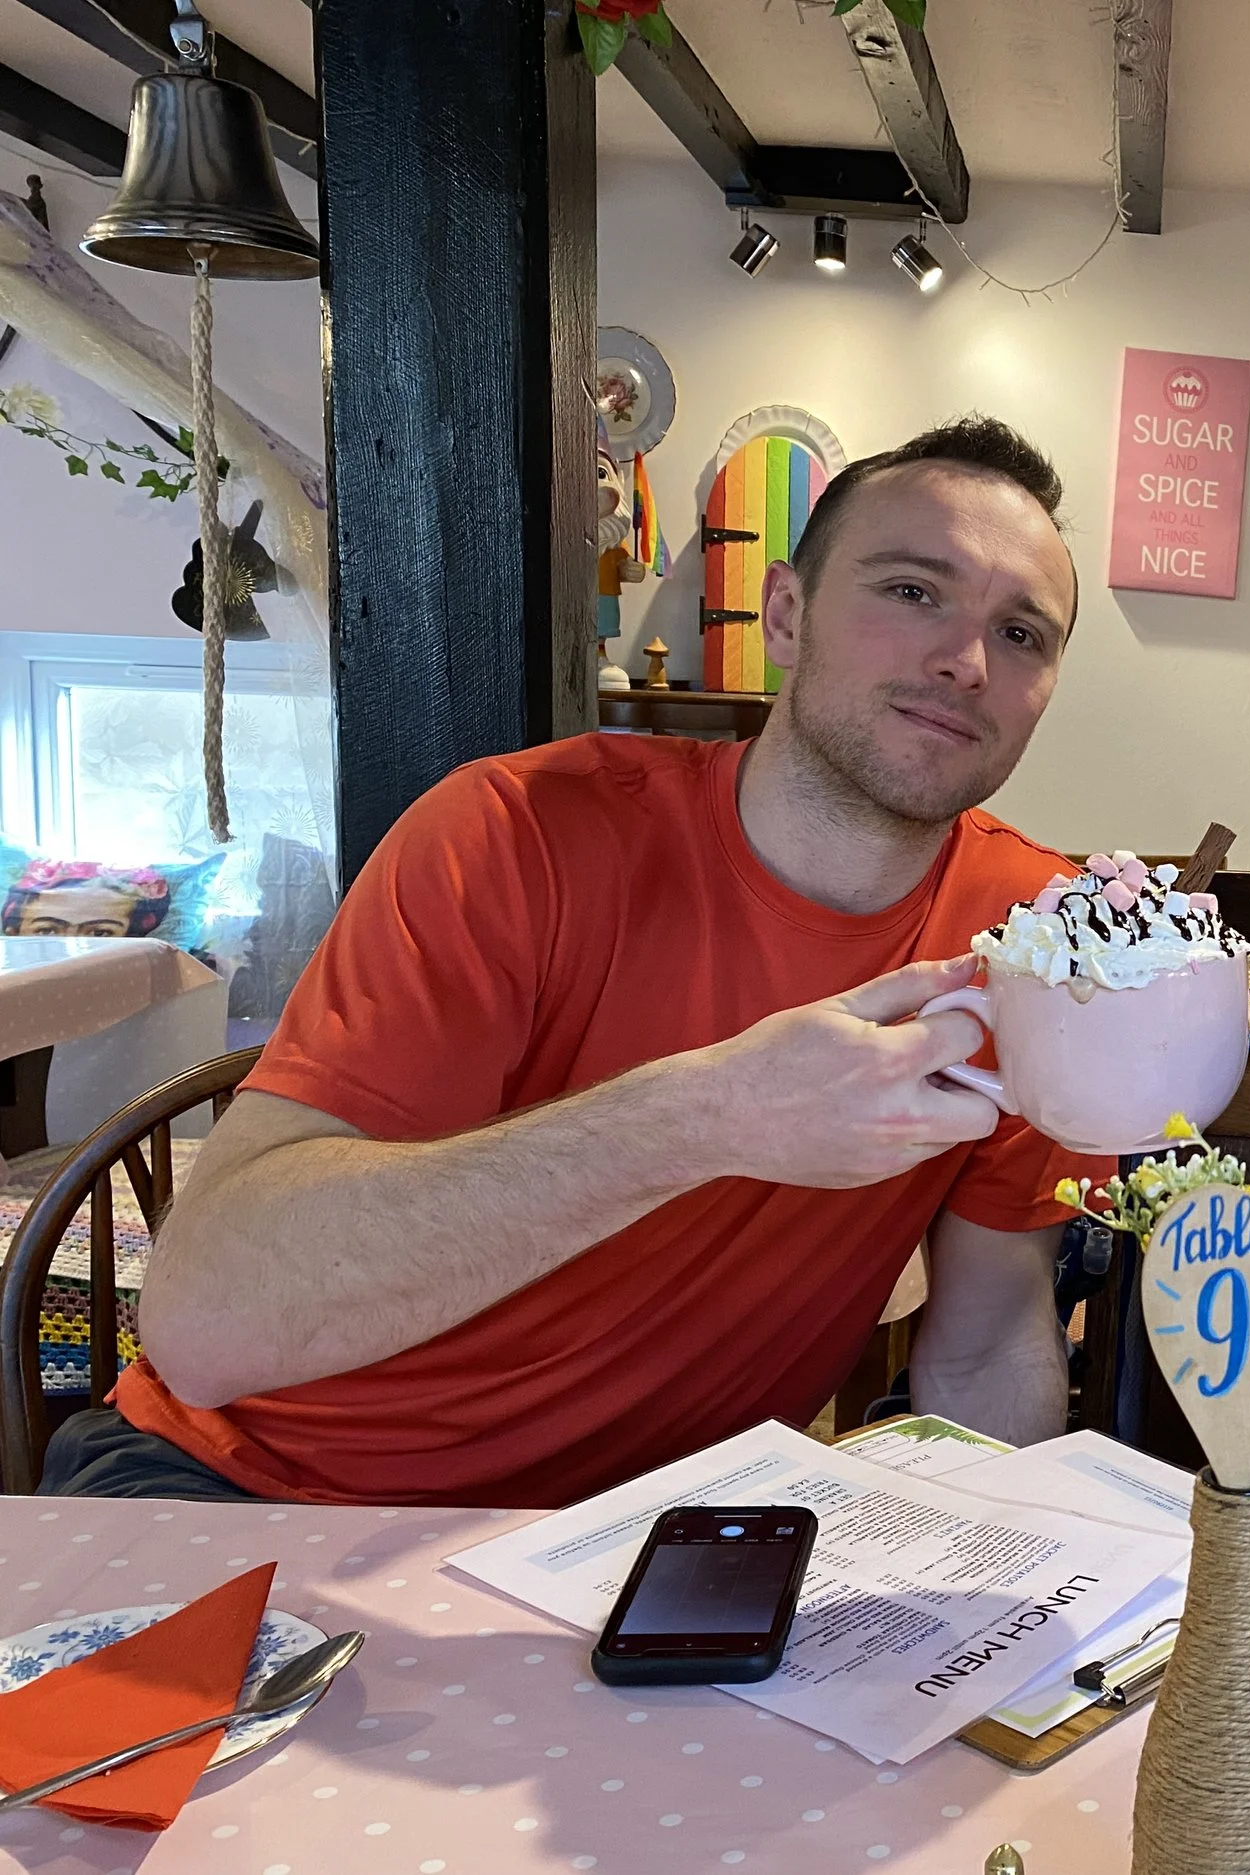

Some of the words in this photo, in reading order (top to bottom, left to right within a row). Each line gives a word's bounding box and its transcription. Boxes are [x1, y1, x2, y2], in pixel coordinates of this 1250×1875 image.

[1132, 414, 1234, 452] SUGAR
[1164, 453, 1198, 471] AND
[1138, 473, 1220, 509] SPICE
[1149, 510, 1178, 524] AND
[1181, 512, 1206, 528] ALL
[1154, 527, 1199, 545] THINGS
[1141, 545, 1207, 578] NICE
[1197, 1268, 1250, 1398] 9
[933, 1520, 972, 1538] PANINI'S
[1036, 1541, 1066, 1562] JACKET
[1000, 1562, 1039, 1587] POTATOES
[800, 1584, 850, 1611] AFTERNOON
[998, 1575, 1098, 1639] LUNCH
[892, 1619, 949, 1654] SANDWICHES
[915, 1641, 1007, 1696] MENU
